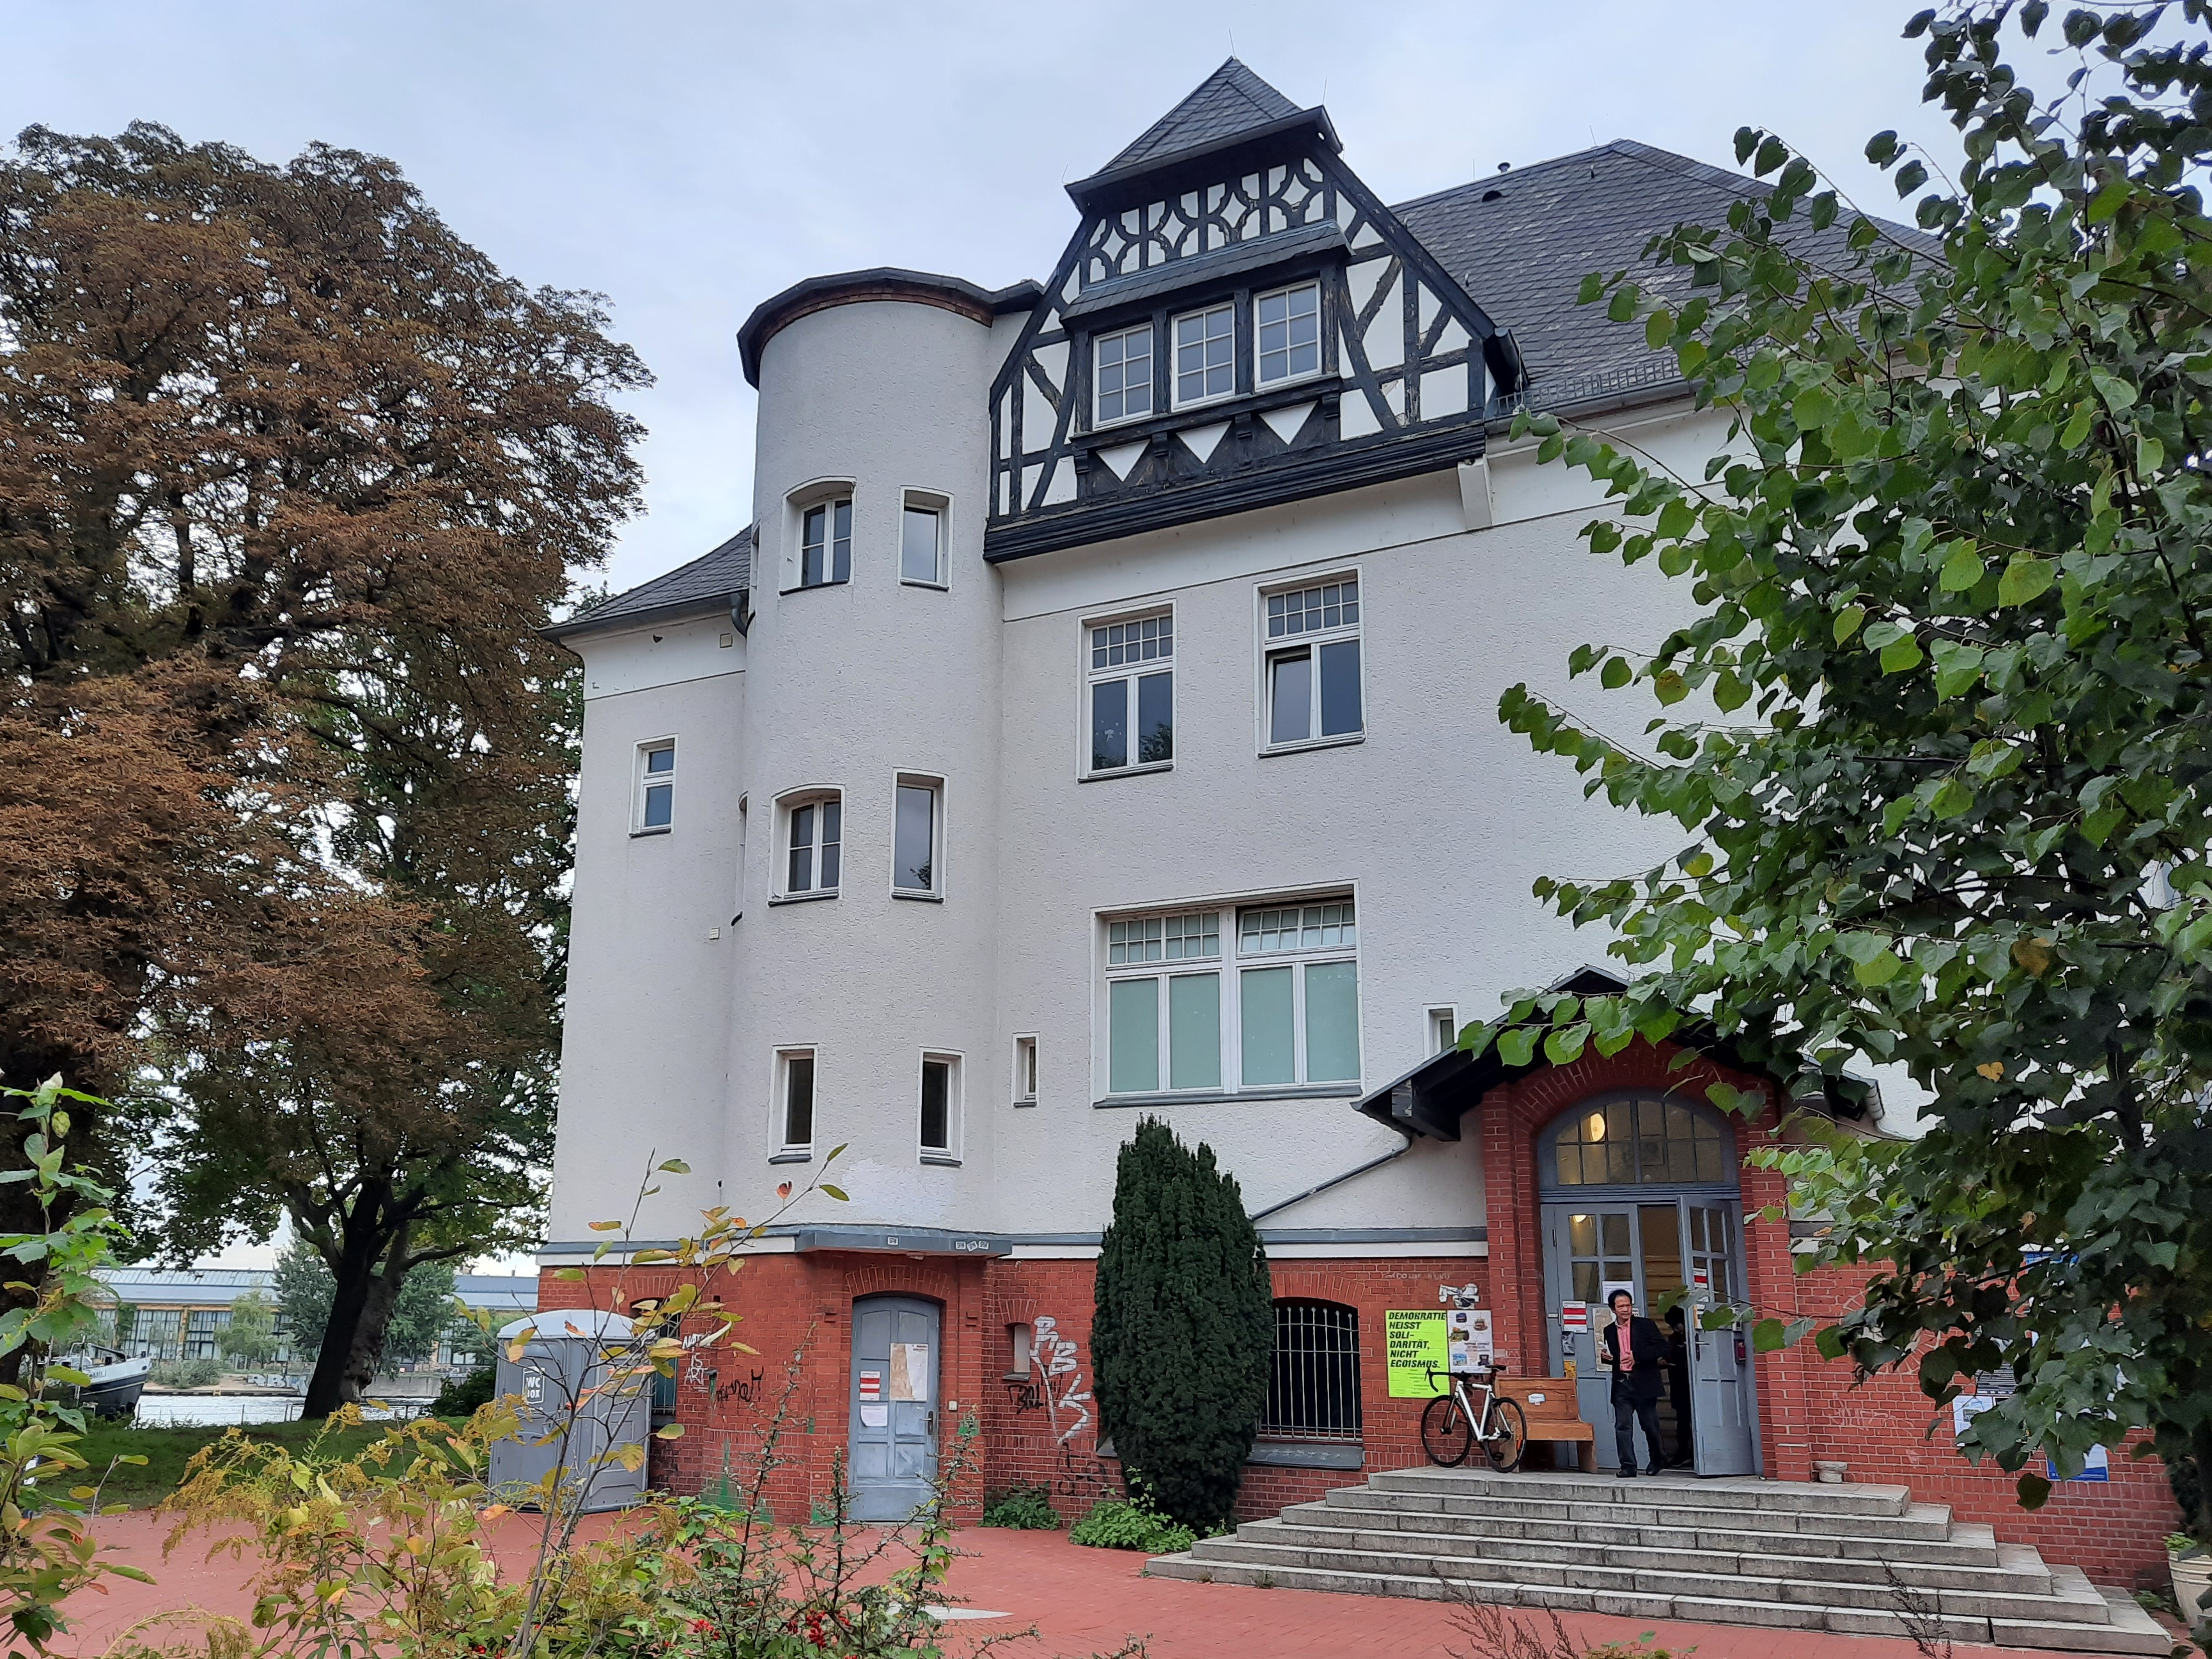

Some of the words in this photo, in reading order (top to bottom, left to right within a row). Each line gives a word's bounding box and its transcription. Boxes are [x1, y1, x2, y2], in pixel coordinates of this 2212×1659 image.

[1389, 1312, 1446, 1320] DEMOKRATIE
[1389, 1321, 1422, 1330] HEISST
[1389, 1339, 1429, 1351] DARITÄT,
[1390, 1350, 1420, 1359] NICHT
[1390, 1359, 1441, 1369] EGOISMUS.
[683, 1367, 708, 1386] ART
[526, 1376, 541, 1388] WC
